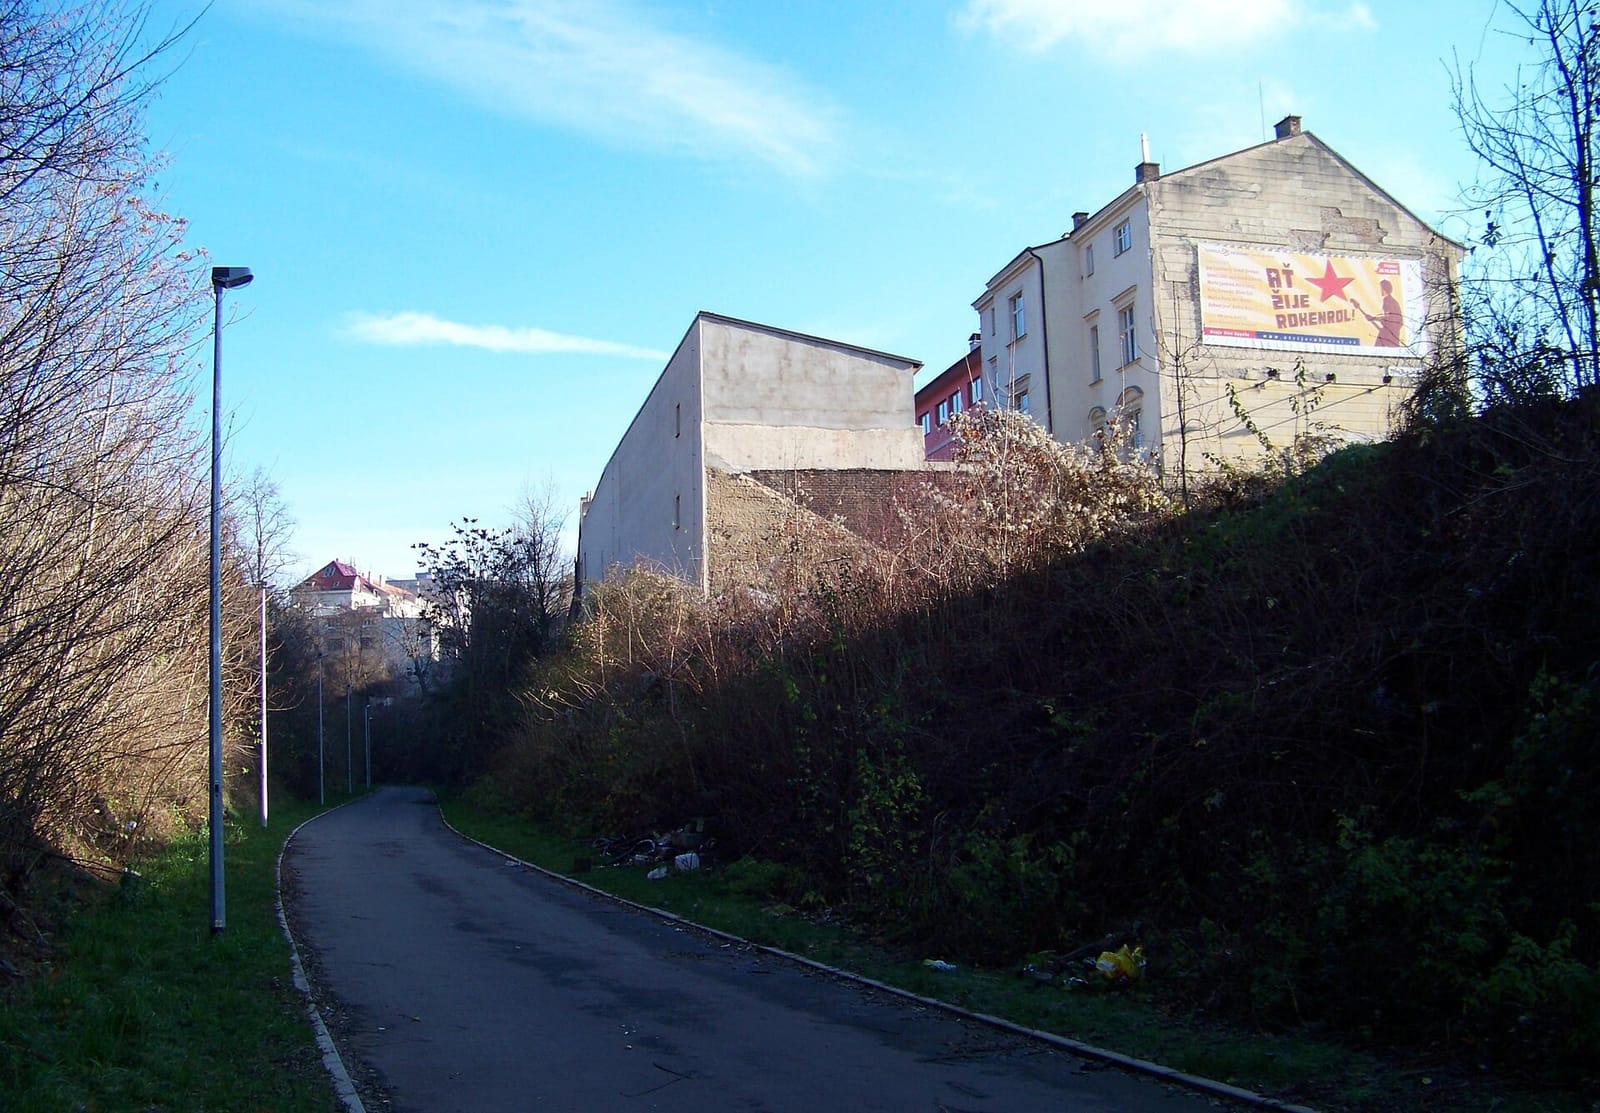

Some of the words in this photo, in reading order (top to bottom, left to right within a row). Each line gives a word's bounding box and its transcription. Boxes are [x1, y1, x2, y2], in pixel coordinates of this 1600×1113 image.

[1266, 263, 1294, 288] AŤ
[1271, 289, 1310, 310] ŽIJE
[1275, 309, 1356, 329] ROKENROL!
